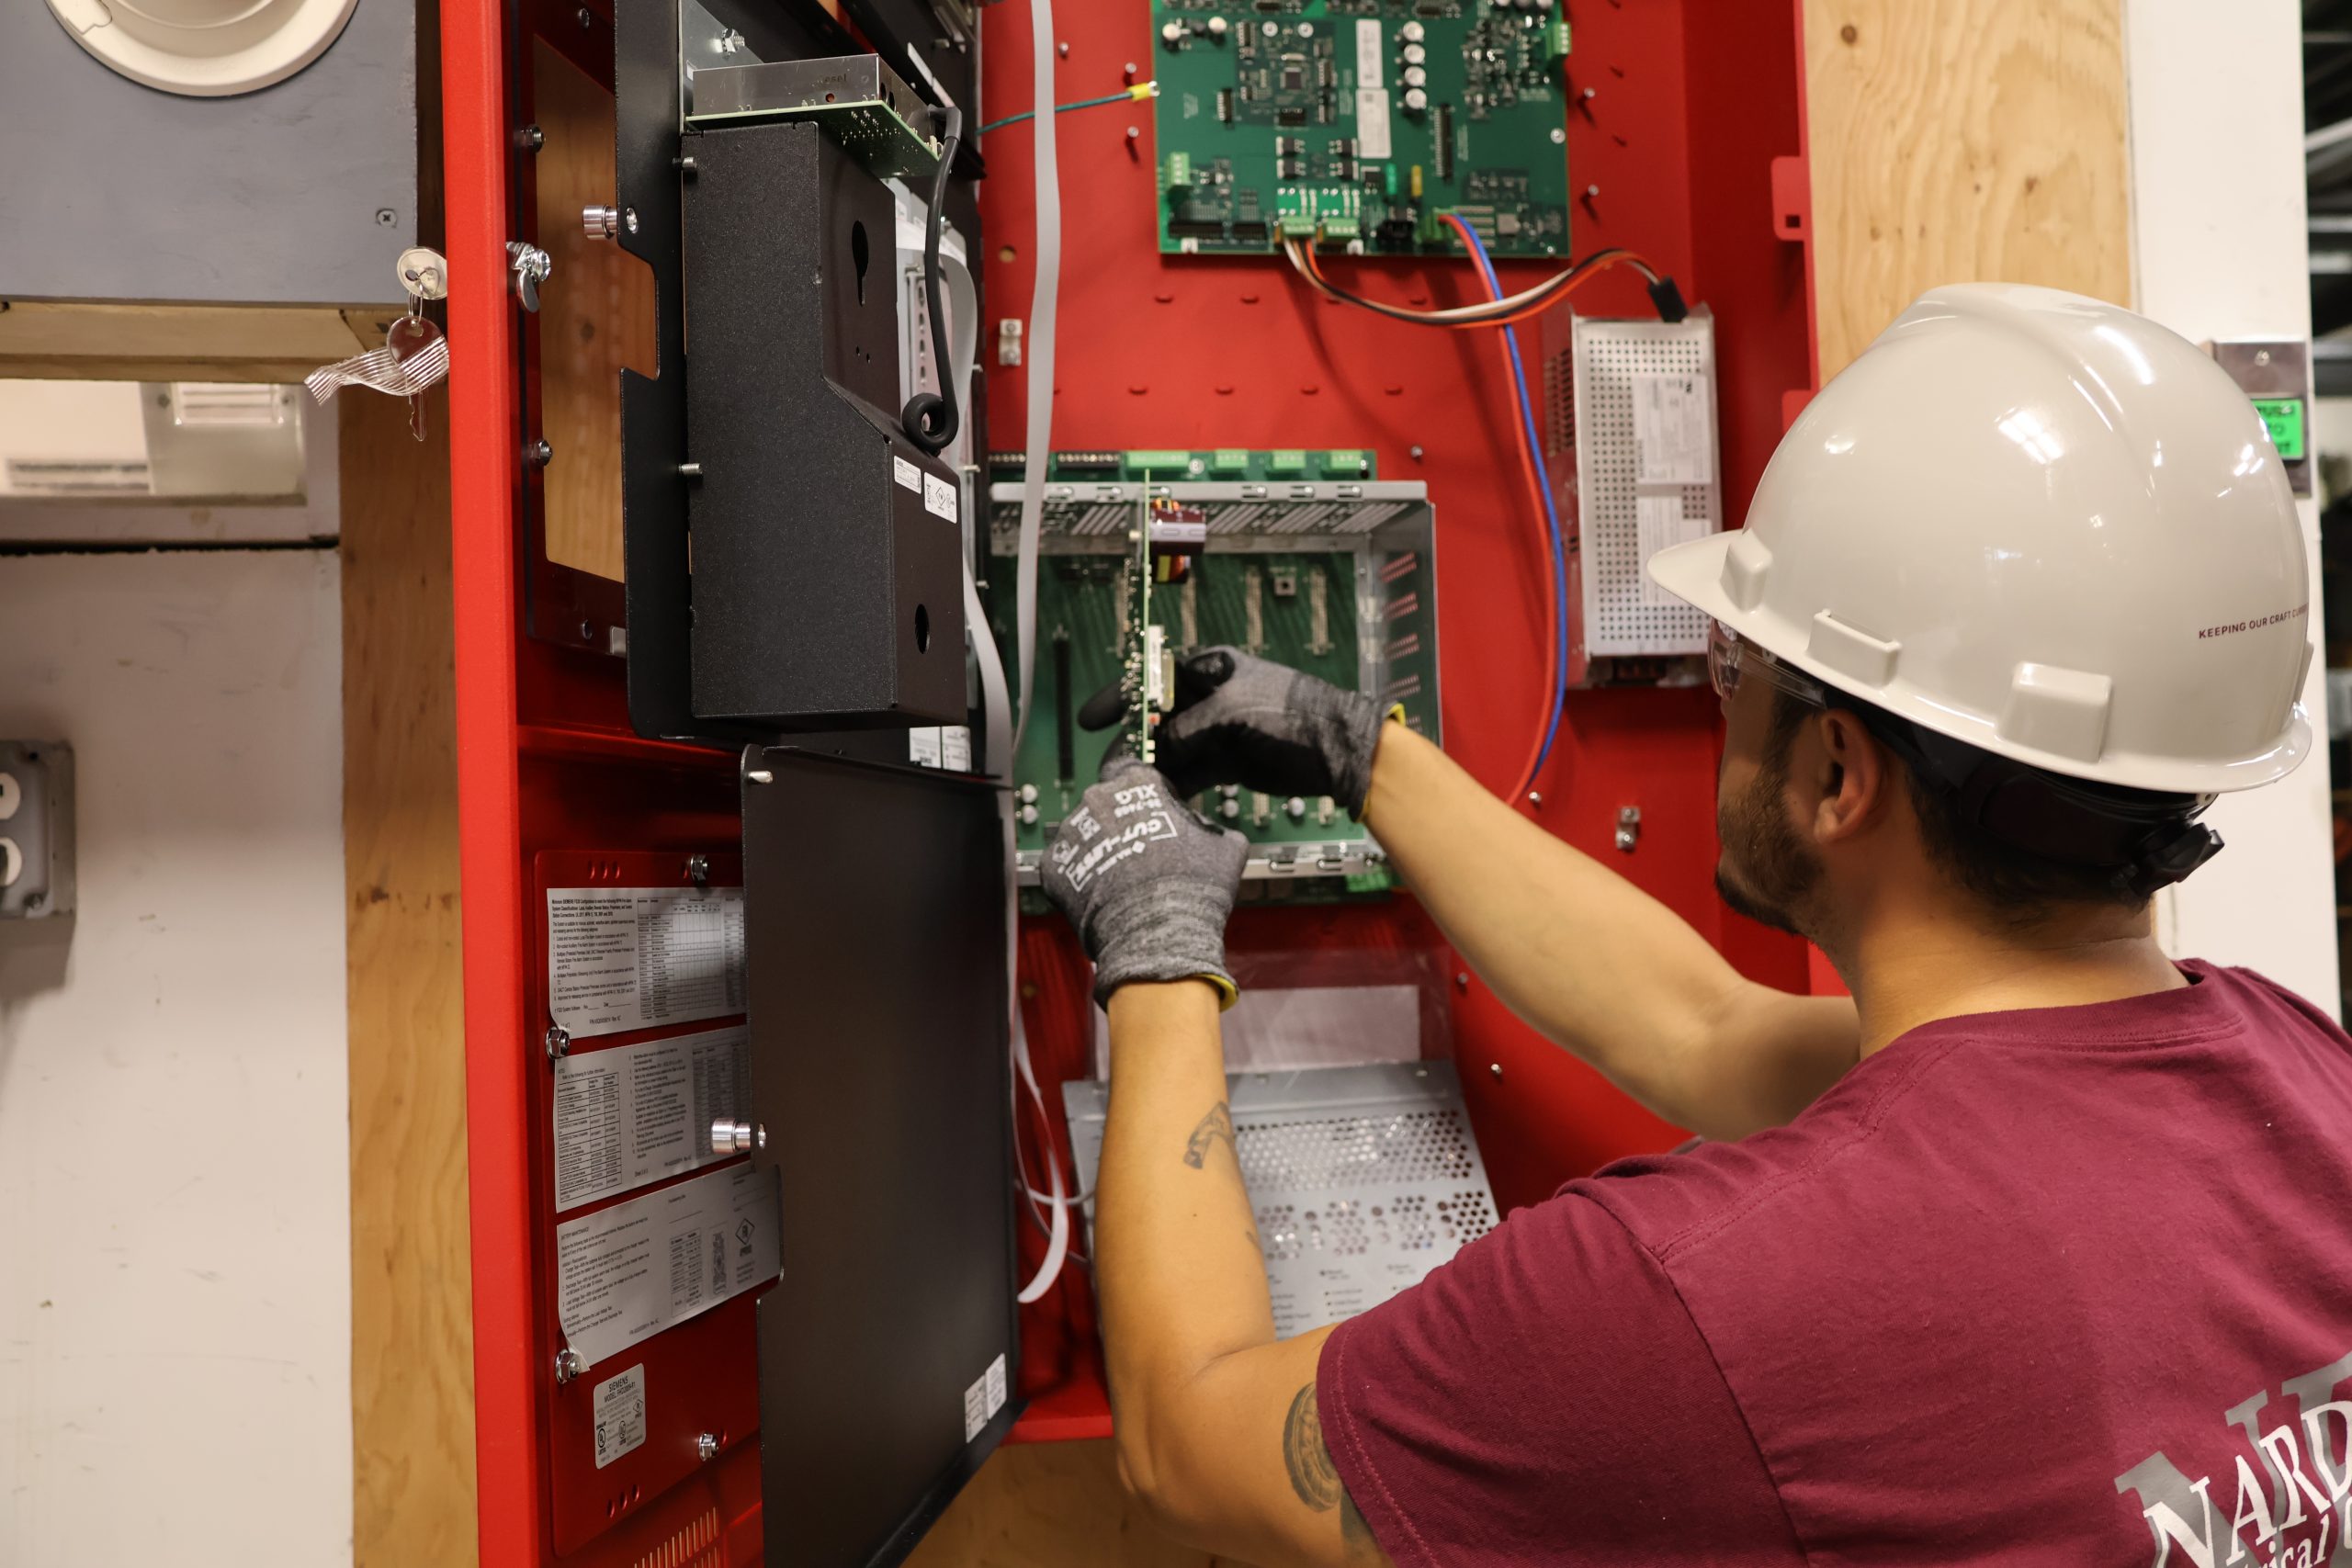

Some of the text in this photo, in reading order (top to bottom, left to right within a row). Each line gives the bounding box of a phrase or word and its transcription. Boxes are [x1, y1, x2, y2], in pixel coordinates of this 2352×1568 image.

[2199, 622, 2246, 638] KEEPING
[2248, 616, 2267, 630] OUR
[2269, 610, 2291, 625] CRAFT
[1114, 784, 1159, 805] XLG
[609, 1376, 628, 1392] SIEMENS
